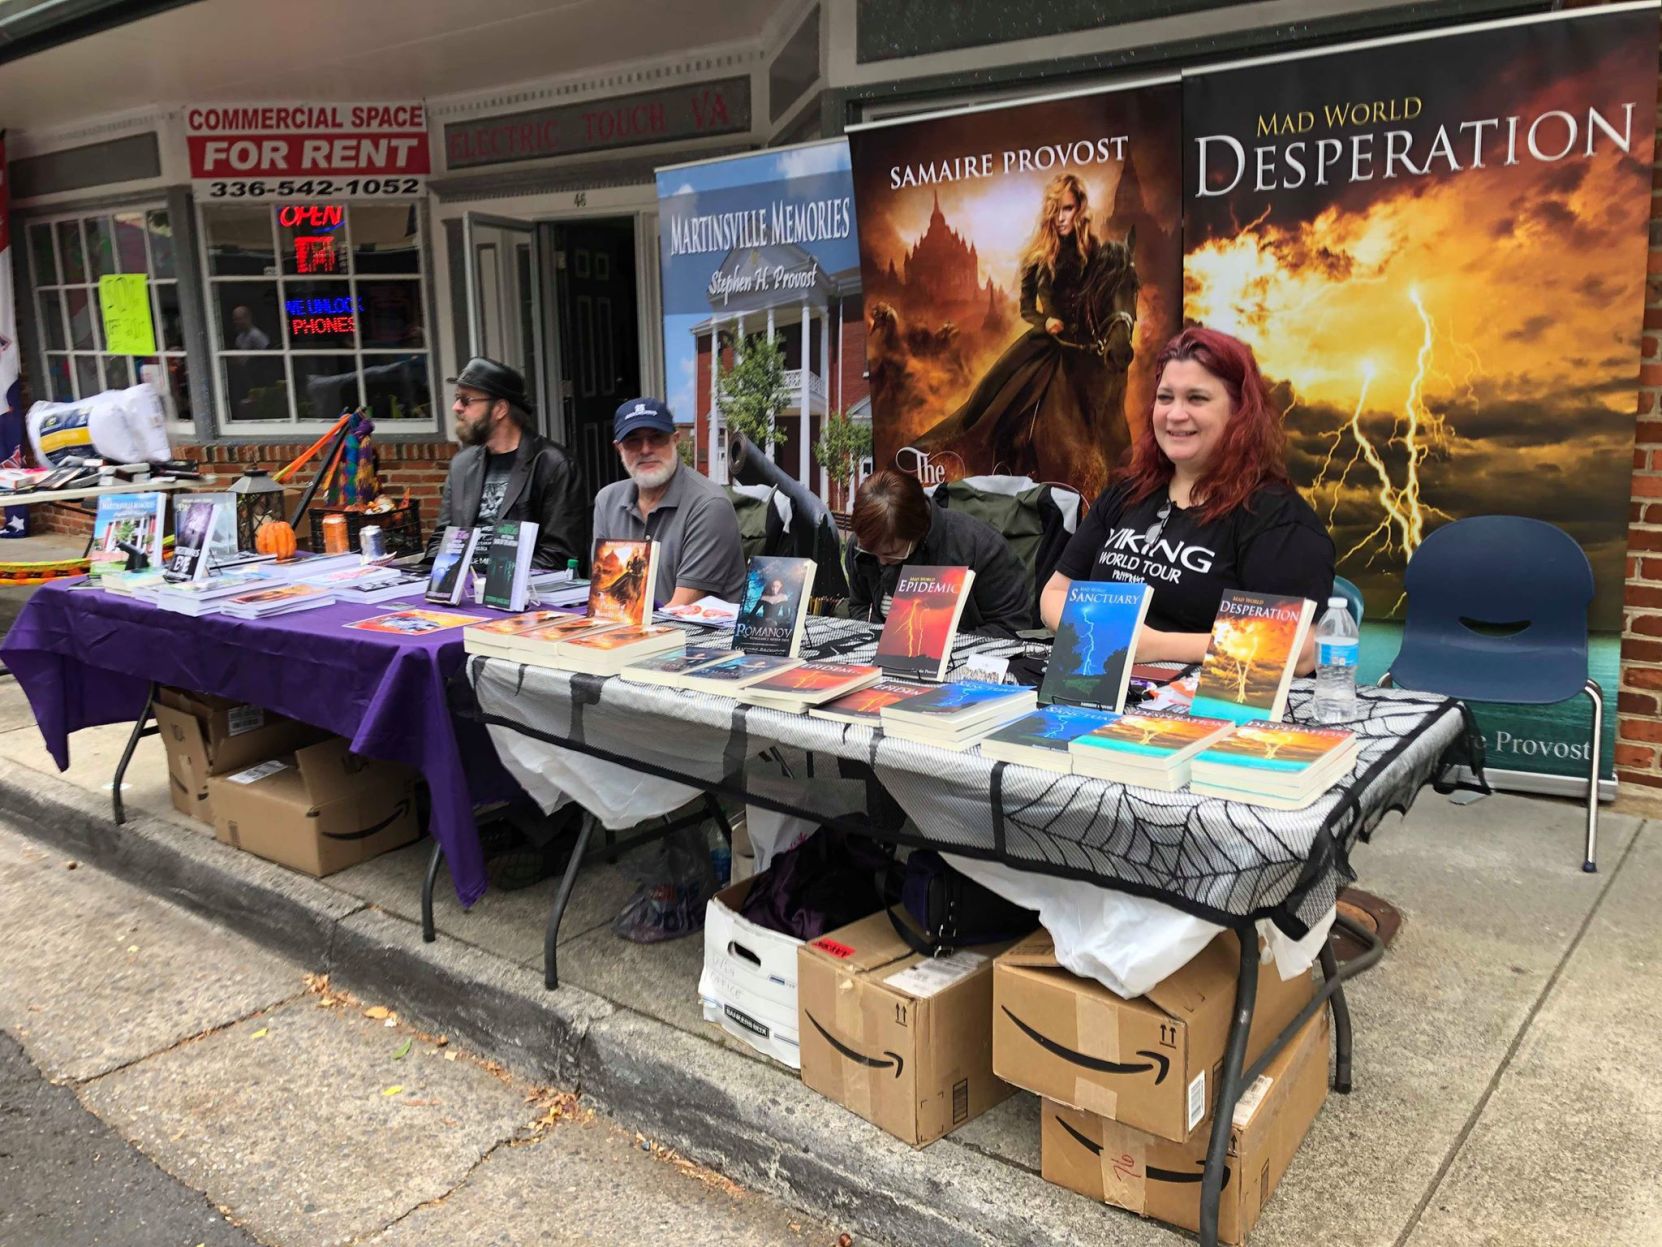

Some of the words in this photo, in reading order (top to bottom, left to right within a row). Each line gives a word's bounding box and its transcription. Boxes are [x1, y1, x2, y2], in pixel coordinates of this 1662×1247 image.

[188, 107, 344, 131] COMMERCIAL
[351, 106, 423, 128] SPACE
[450, 119, 560, 160] ELECTRIC
[580, 104, 667, 141] TOUCH
[1256, 110, 1315, 139] MAD
[1323, 96, 1423, 129] WORLD
[203, 140, 289, 171] FOR
[301, 138, 419, 169] RENT
[890, 153, 993, 190] SAMAIRE
[1002, 135, 1129, 175] PROVOST
[1193, 102, 1637, 199] DESPERATION
[209, 178, 419, 198] 336-542-1052
[279, 204, 343, 227] OPEN
[671, 208, 768, 256] MARTINSVILLE
[771, 197, 850, 246] MEMORIES
[708, 264, 751, 306] Stephen
[755, 266, 769, 291] H.
[773, 262, 818, 290] Provost
[286, 300, 304, 315] WE
[292, 316, 356, 335] PHONES
[896, 446, 945, 483] The
[1104, 528, 1216, 574] VIKING
[1099, 551, 1141, 571] WORLD
[1142, 560, 1182, 584] TOUR
[898, 580, 962, 594] EPIDEMIC
[1069, 588, 1140, 605] SANCTUARY
[1220, 600, 1300, 622] DESPERATION
[735, 623, 793, 639] ROMANOV
[1496, 730, 1592, 760] Provost
